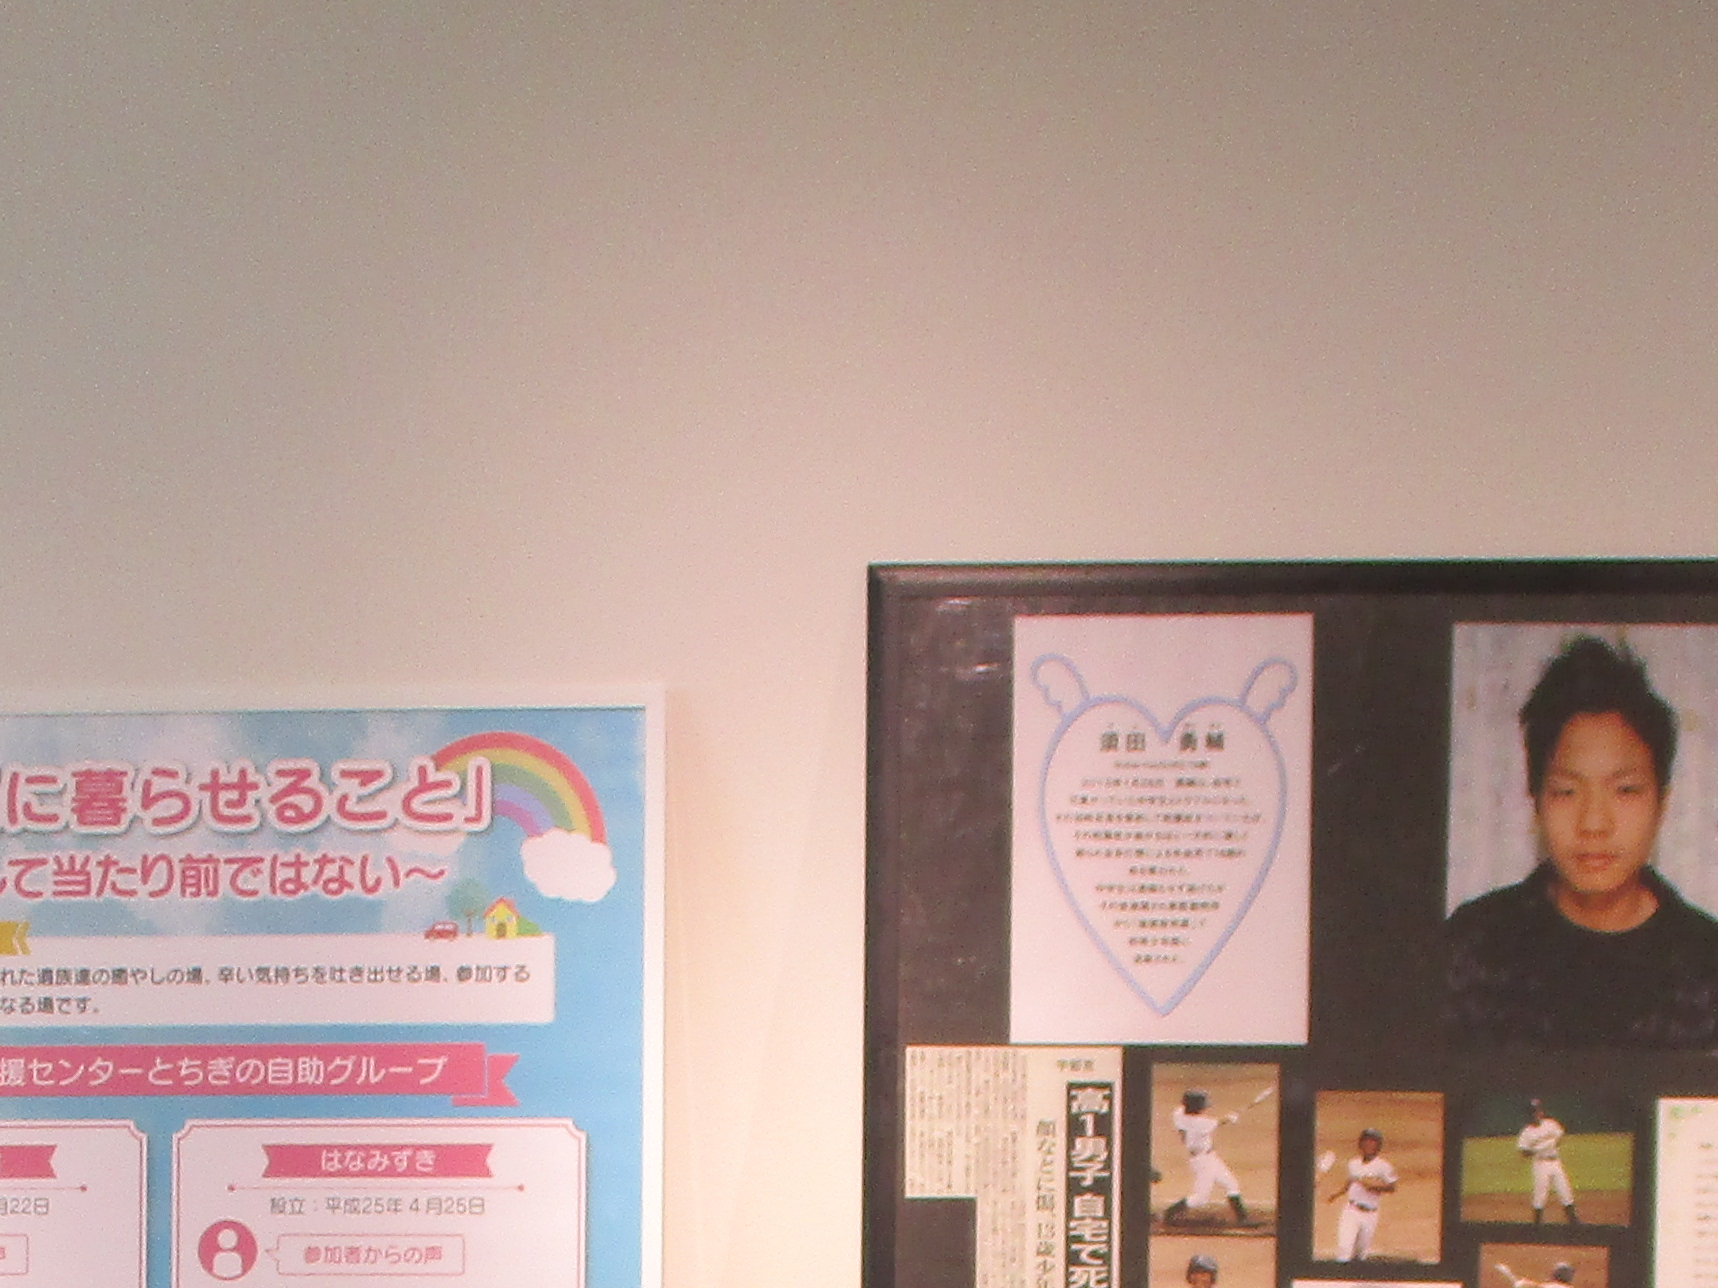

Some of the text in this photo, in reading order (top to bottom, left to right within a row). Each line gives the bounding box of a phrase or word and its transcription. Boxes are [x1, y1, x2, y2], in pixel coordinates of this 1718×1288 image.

[1069, 1087, 1112, 1187] 高1男子
[321, 1149, 437, 1172] はなみずき
[303, 1245, 443, 1264] 参加者からの声
